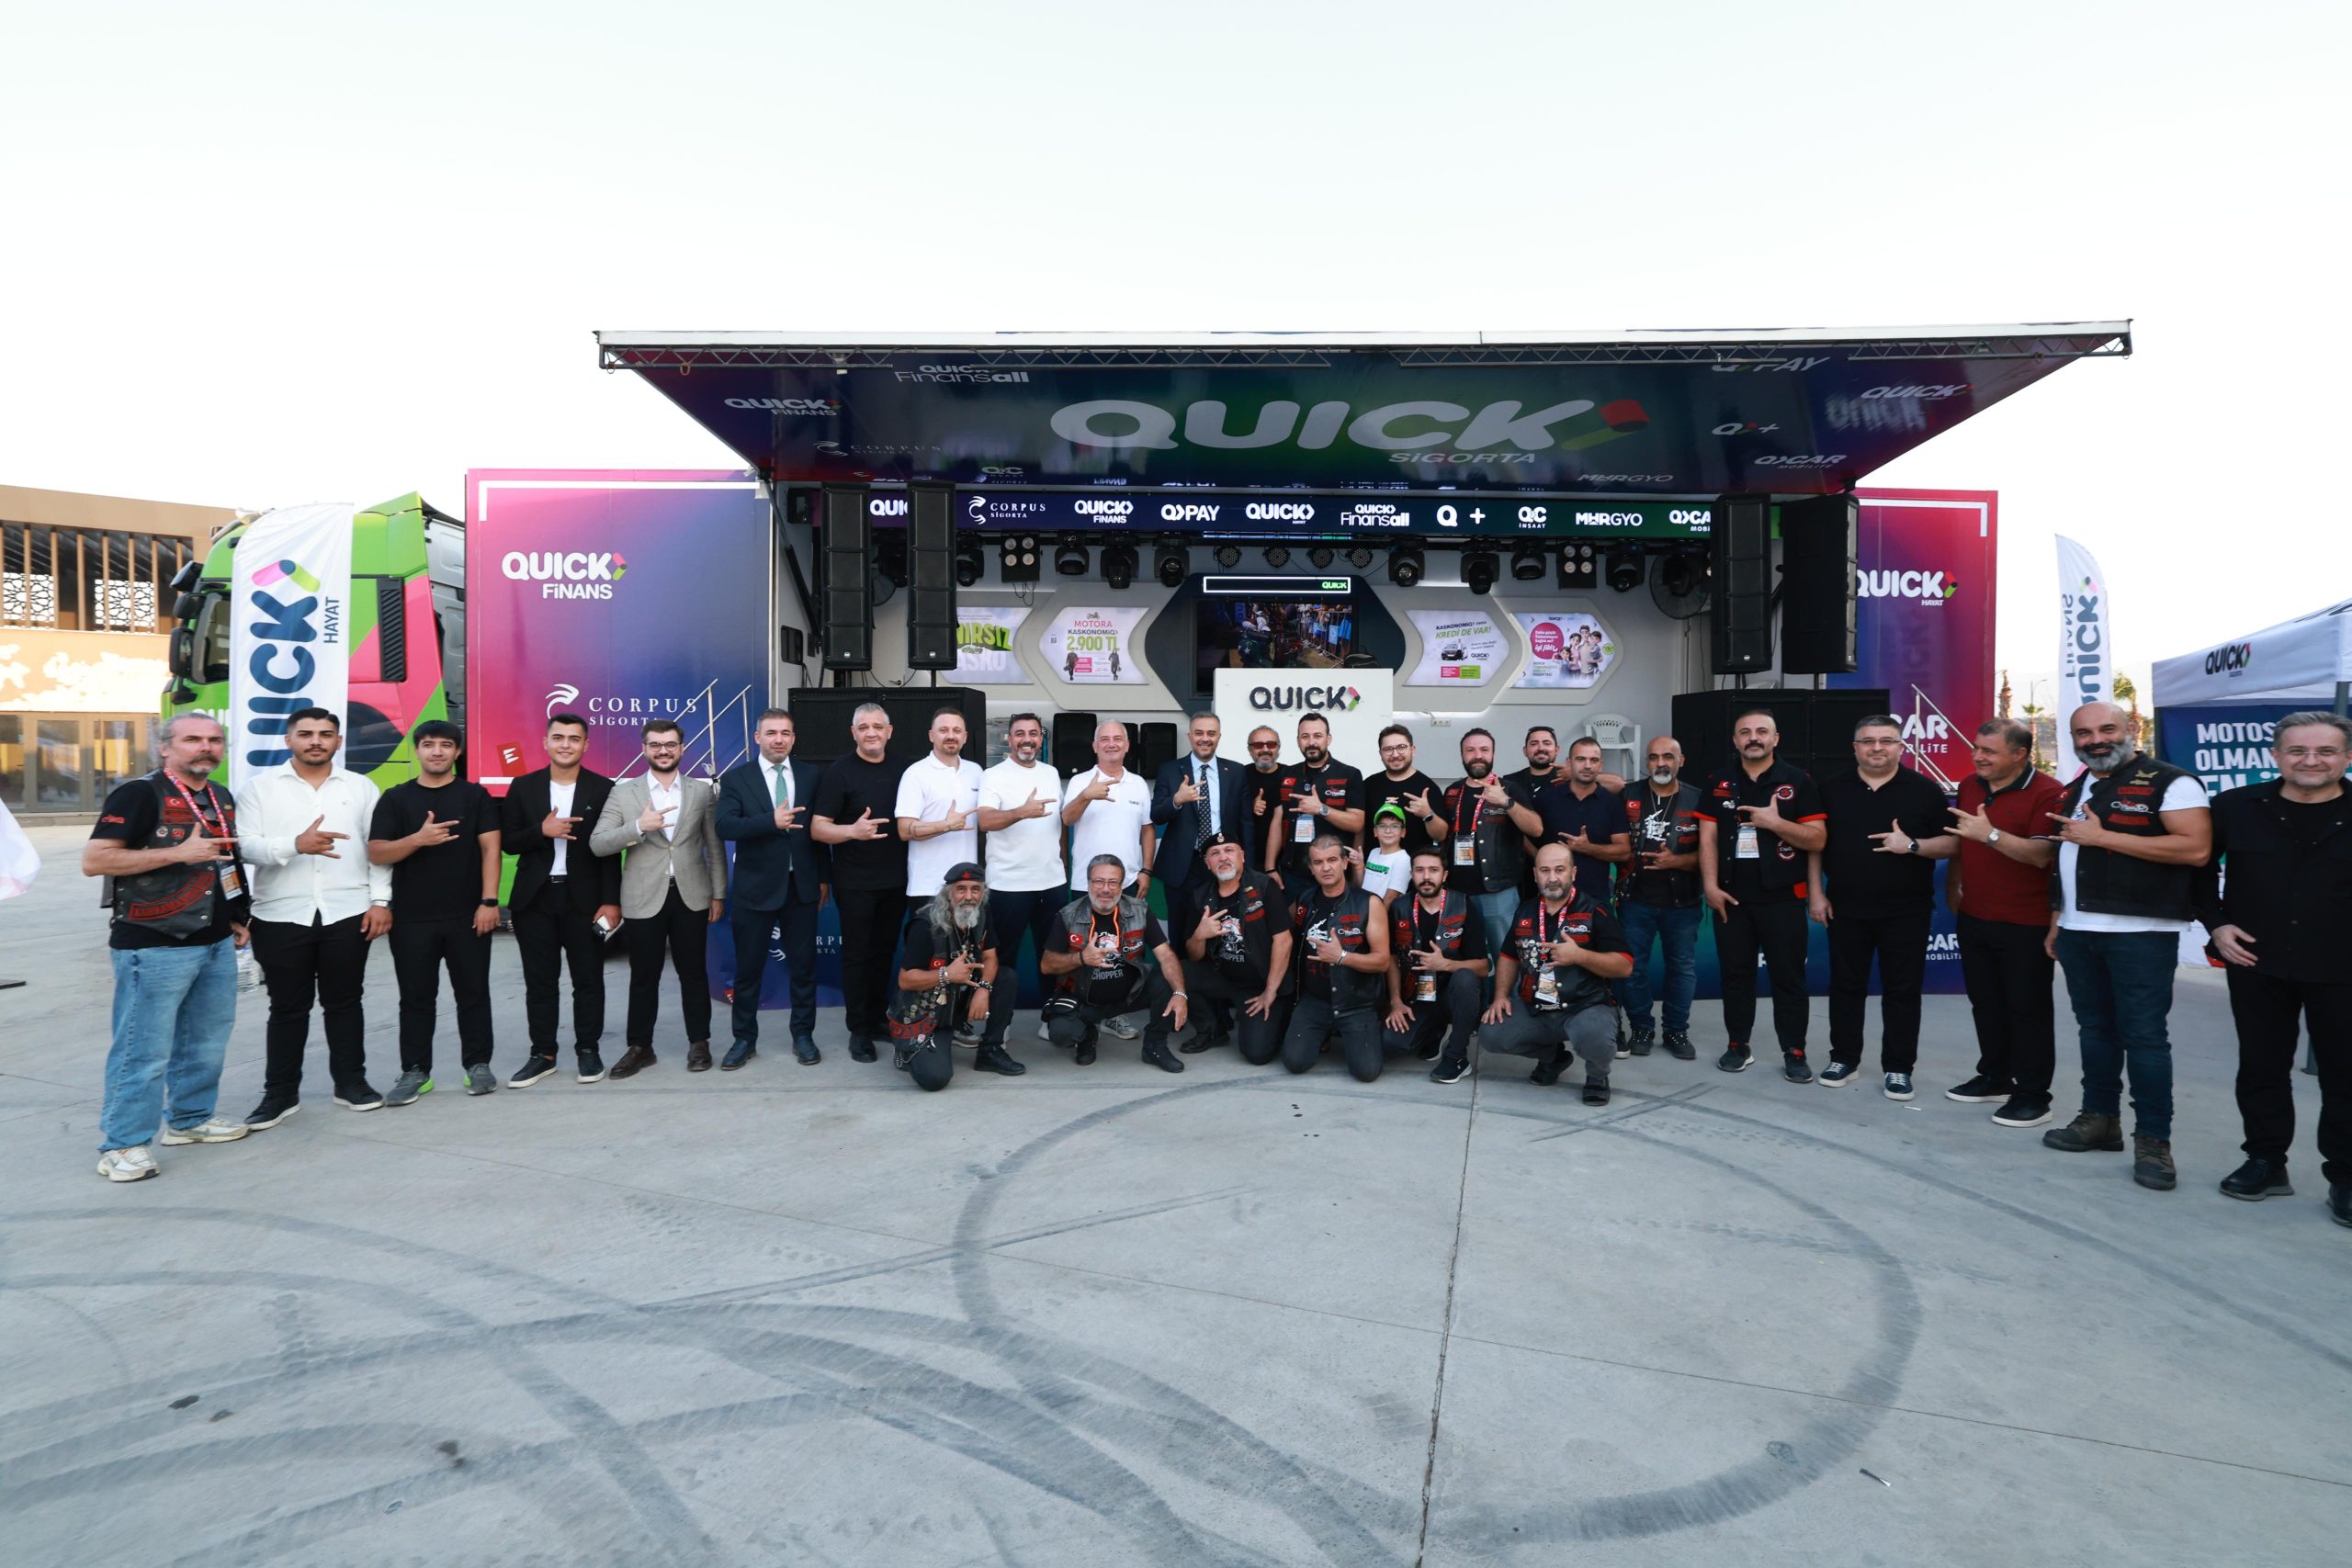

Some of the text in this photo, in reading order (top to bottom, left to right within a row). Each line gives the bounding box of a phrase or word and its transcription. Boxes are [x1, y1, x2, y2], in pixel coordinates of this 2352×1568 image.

[1860, 384, 1968, 399] QUICK
[724, 398, 831, 410] QUICK
[1050, 399, 1595, 450] QUICK
[989, 502, 1046, 512] CORPUS
[1074, 500, 1126, 514] QUICK
[1246, 503, 1306, 521] QUICK
[1354, 504, 1390, 514] QUICK
[1340, 512, 1409, 526] Finansall
[502, 551, 612, 581] QUICK
[1322, 581, 1348, 590] QUICK
[323, 596, 340, 644] HAYAT
[1074, 620, 1113, 628] MOTORA
[1067, 636, 1102, 650] 2.900
[2206, 643, 2245, 675] QUICK
[588, 696, 697, 714] CORPUS
[1249, 685, 1348, 711] QUICK
[589, 714, 662, 726] SİGORT
[1091, 969, 1124, 980] CHOPPER
